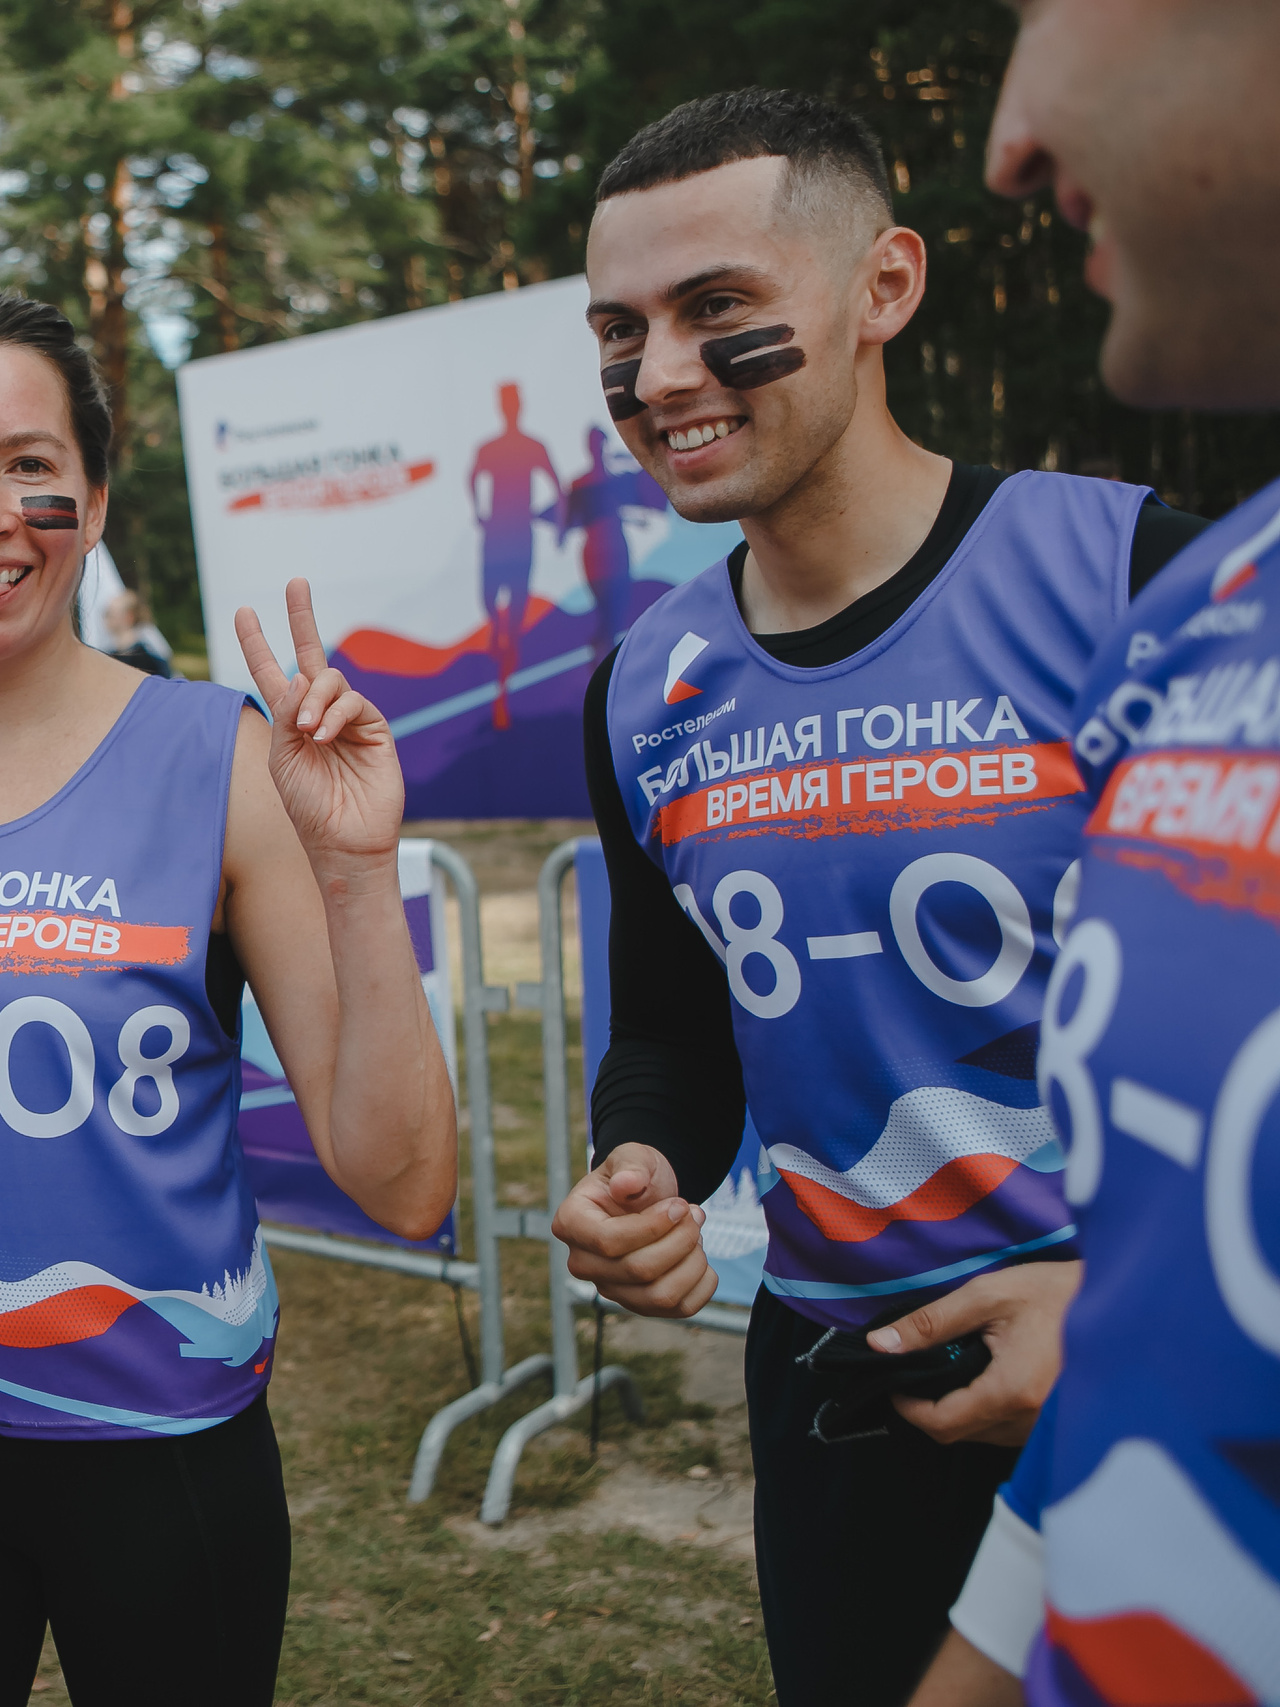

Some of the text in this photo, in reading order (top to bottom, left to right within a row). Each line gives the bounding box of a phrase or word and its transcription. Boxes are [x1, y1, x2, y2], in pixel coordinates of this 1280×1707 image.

[637, 695, 1029, 807] БОЛЬШАЯ ГОНКА
[707, 752, 1038, 827] ВРЕМЯ ГЕРОЕВ
[673, 852, 1082, 1019] 8-0
